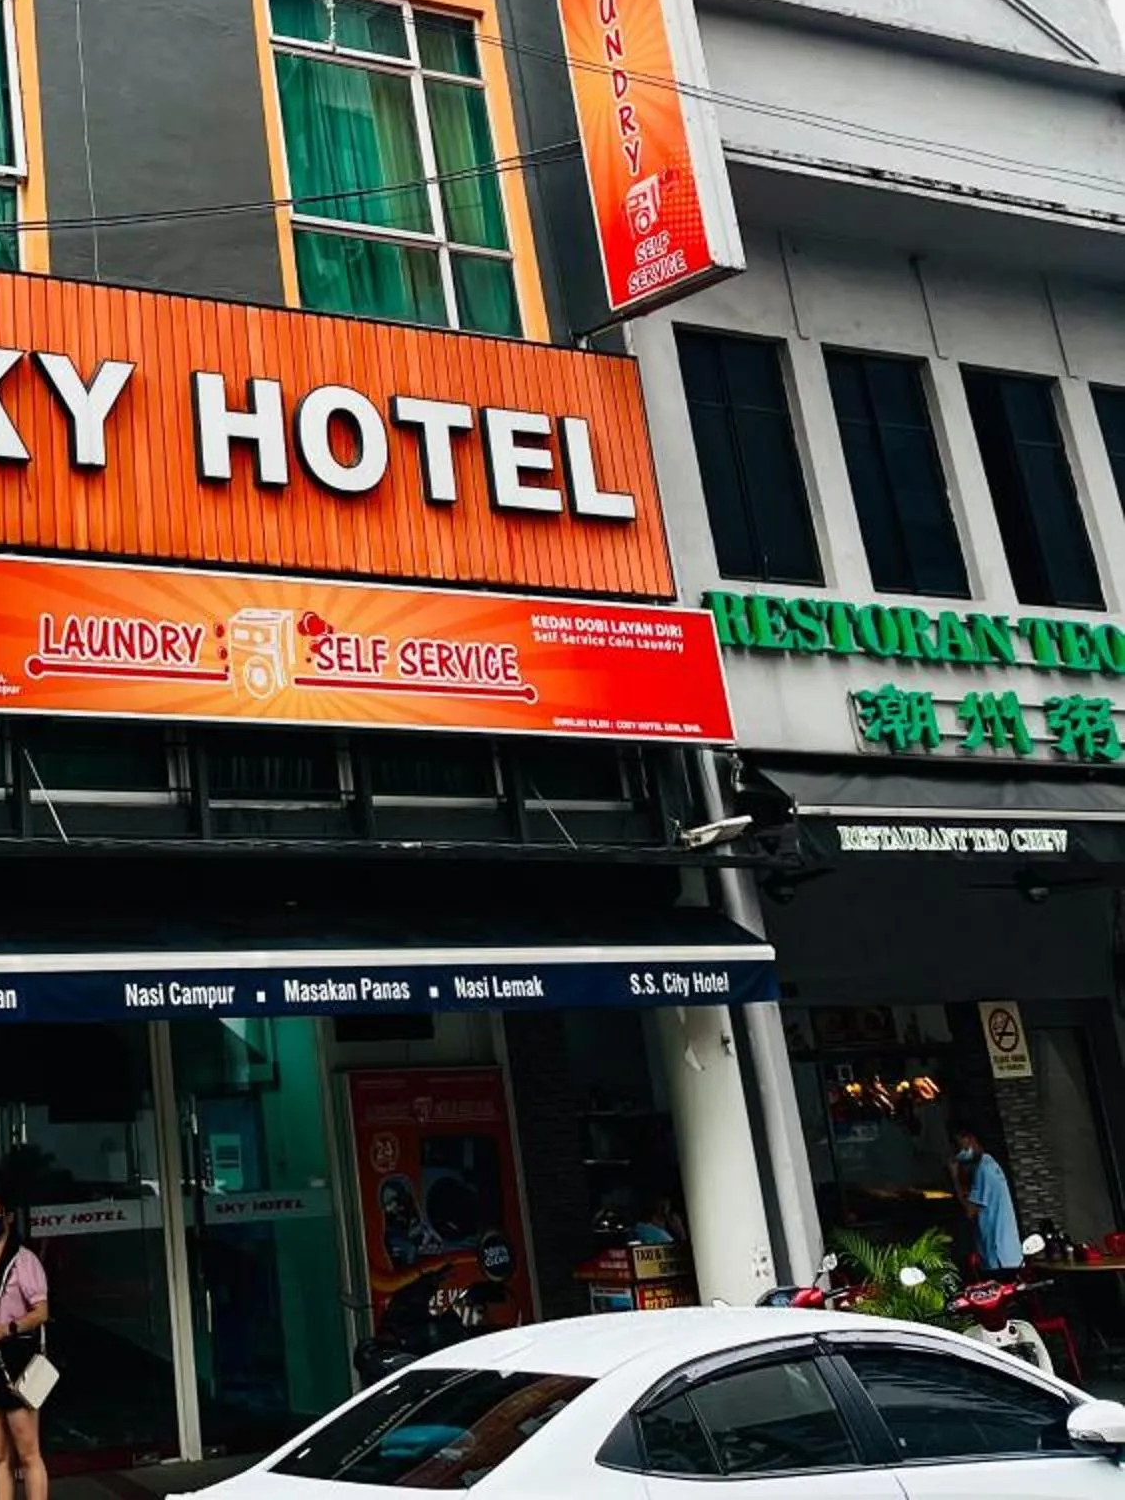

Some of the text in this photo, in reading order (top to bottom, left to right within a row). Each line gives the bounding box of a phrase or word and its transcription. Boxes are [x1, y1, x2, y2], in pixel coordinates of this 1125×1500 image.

[635, 231, 669, 265] SELF
[628, 250, 688, 295] SERVICE
[193, 366, 637, 522] HOTEL
[530, 614, 684, 638] KEDAI DOBI LAYAN DIRI
[533, 631, 684, 654] Self Service Coin Laundry
[702, 590, 1016, 665] RESTORAN
[40, 614, 520, 683] LAUNDRY SELF SERVICE
[858, 683, 1124, 762] 潮州粥
[836, 825, 968, 852] RESTAURANT
[125, 983, 165, 1008] Nasi
[169, 981, 235, 1009] Campur
[283, 977, 357, 1003] Masakan
[360, 977, 411, 1001] Panas
[454, 975, 490, 999] Nasi
[493, 974, 545, 998] Lemak
[629, 973, 661, 996] S.S.
[662, 971, 691, 998] City
[693, 970, 730, 994] Hotel
[29, 1210, 127, 1228] SKY HOTEL
